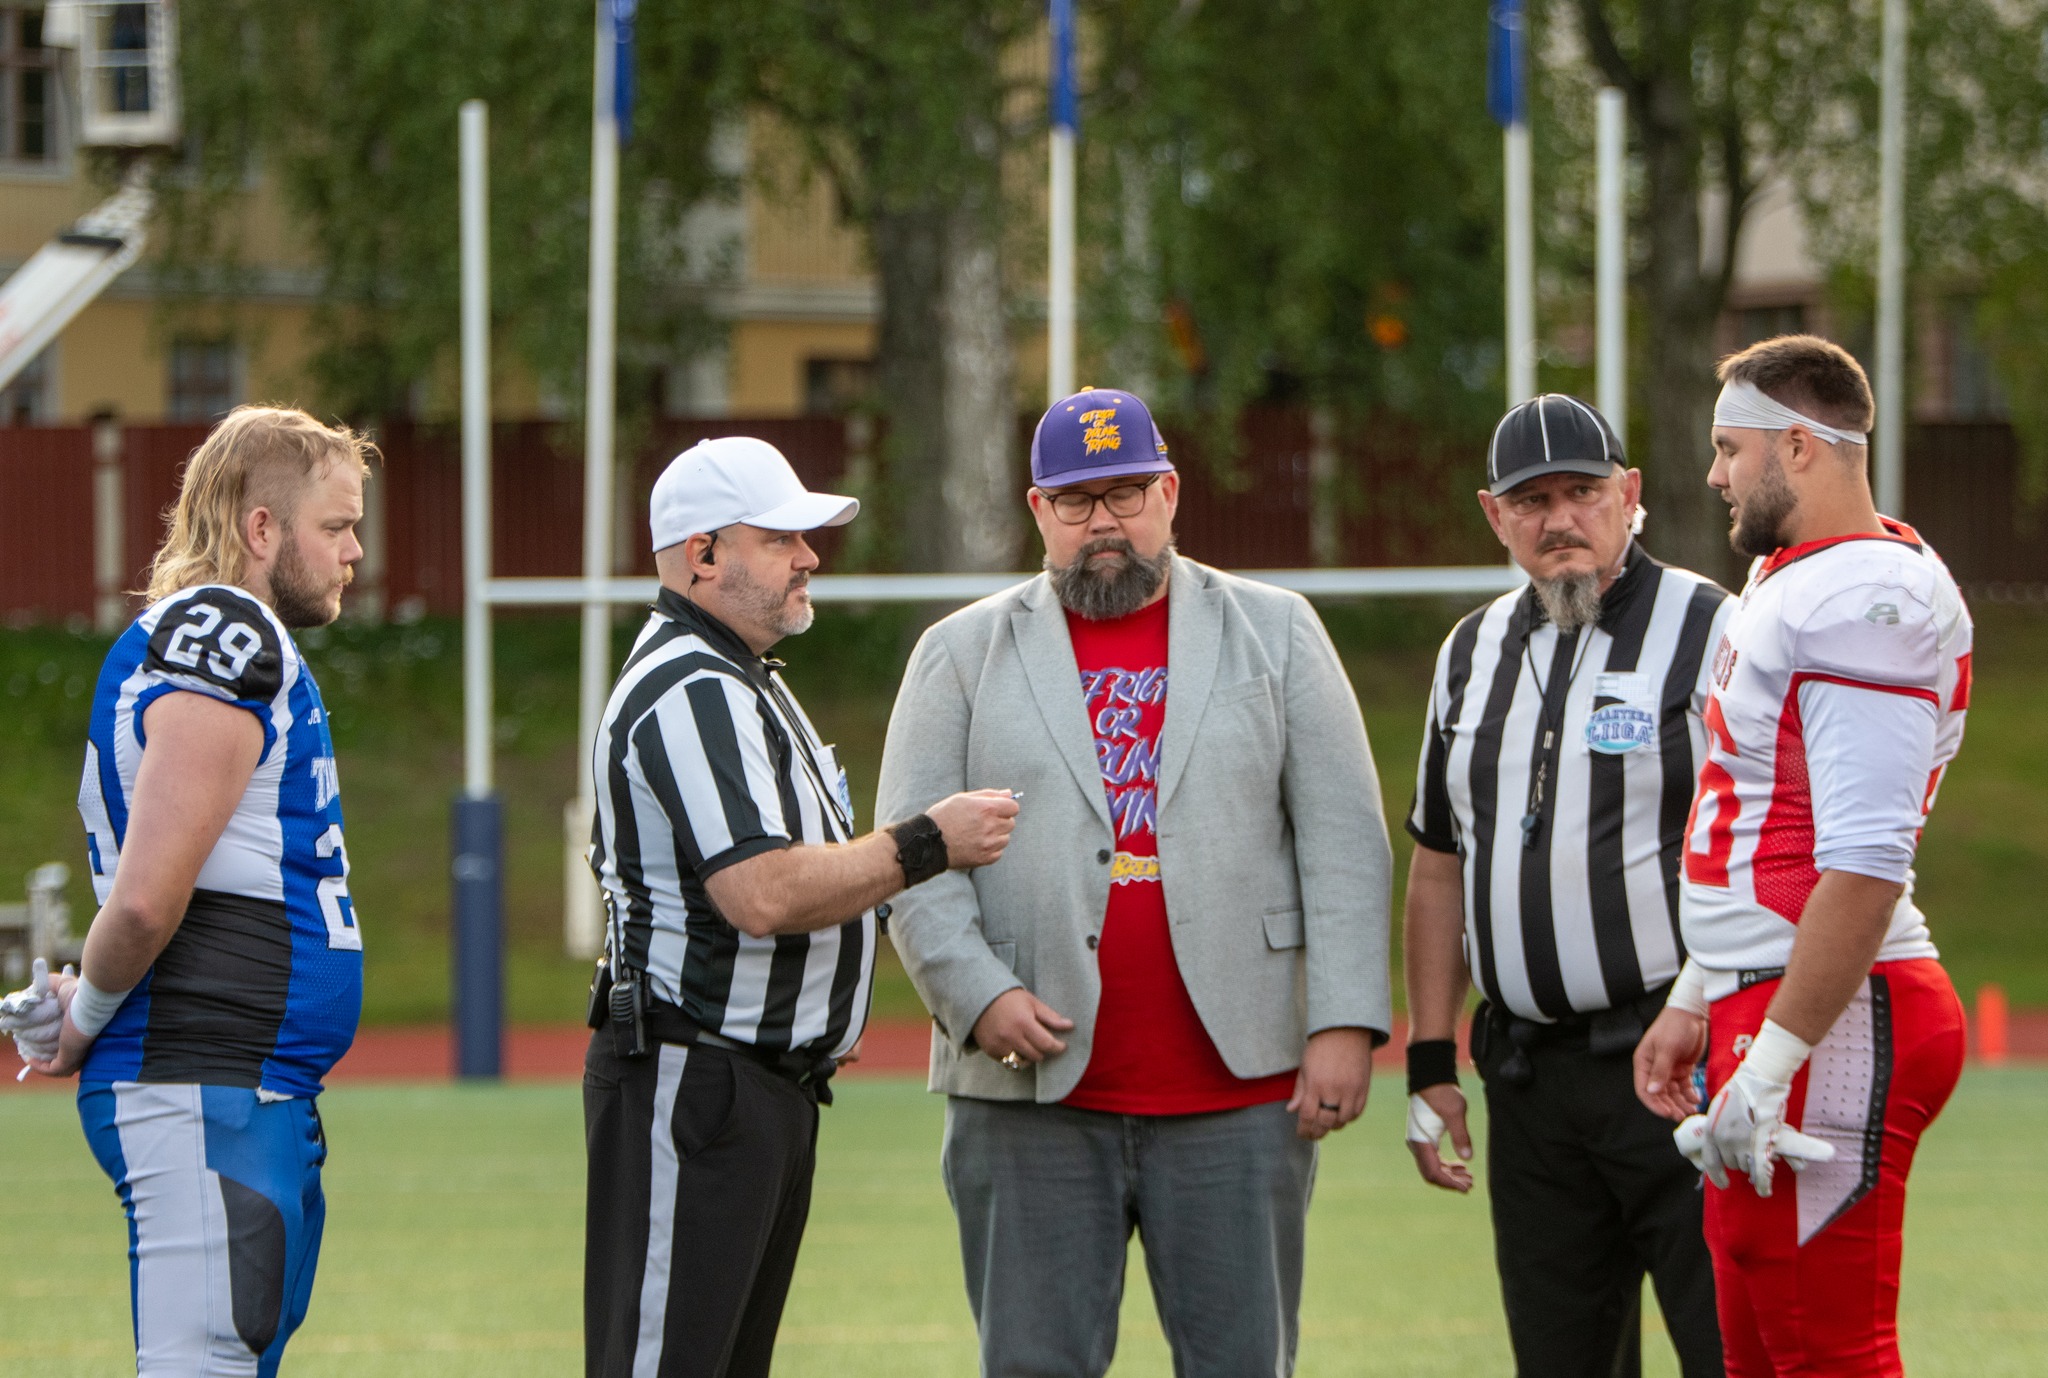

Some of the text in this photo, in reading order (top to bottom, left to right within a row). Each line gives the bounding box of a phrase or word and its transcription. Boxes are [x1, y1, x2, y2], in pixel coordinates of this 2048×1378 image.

[164, 603, 263, 681] 29
[1096, 705, 1142, 740] OR
[1587, 721, 1652, 745] LIIGA
[1095, 736, 1164, 786] RUN
